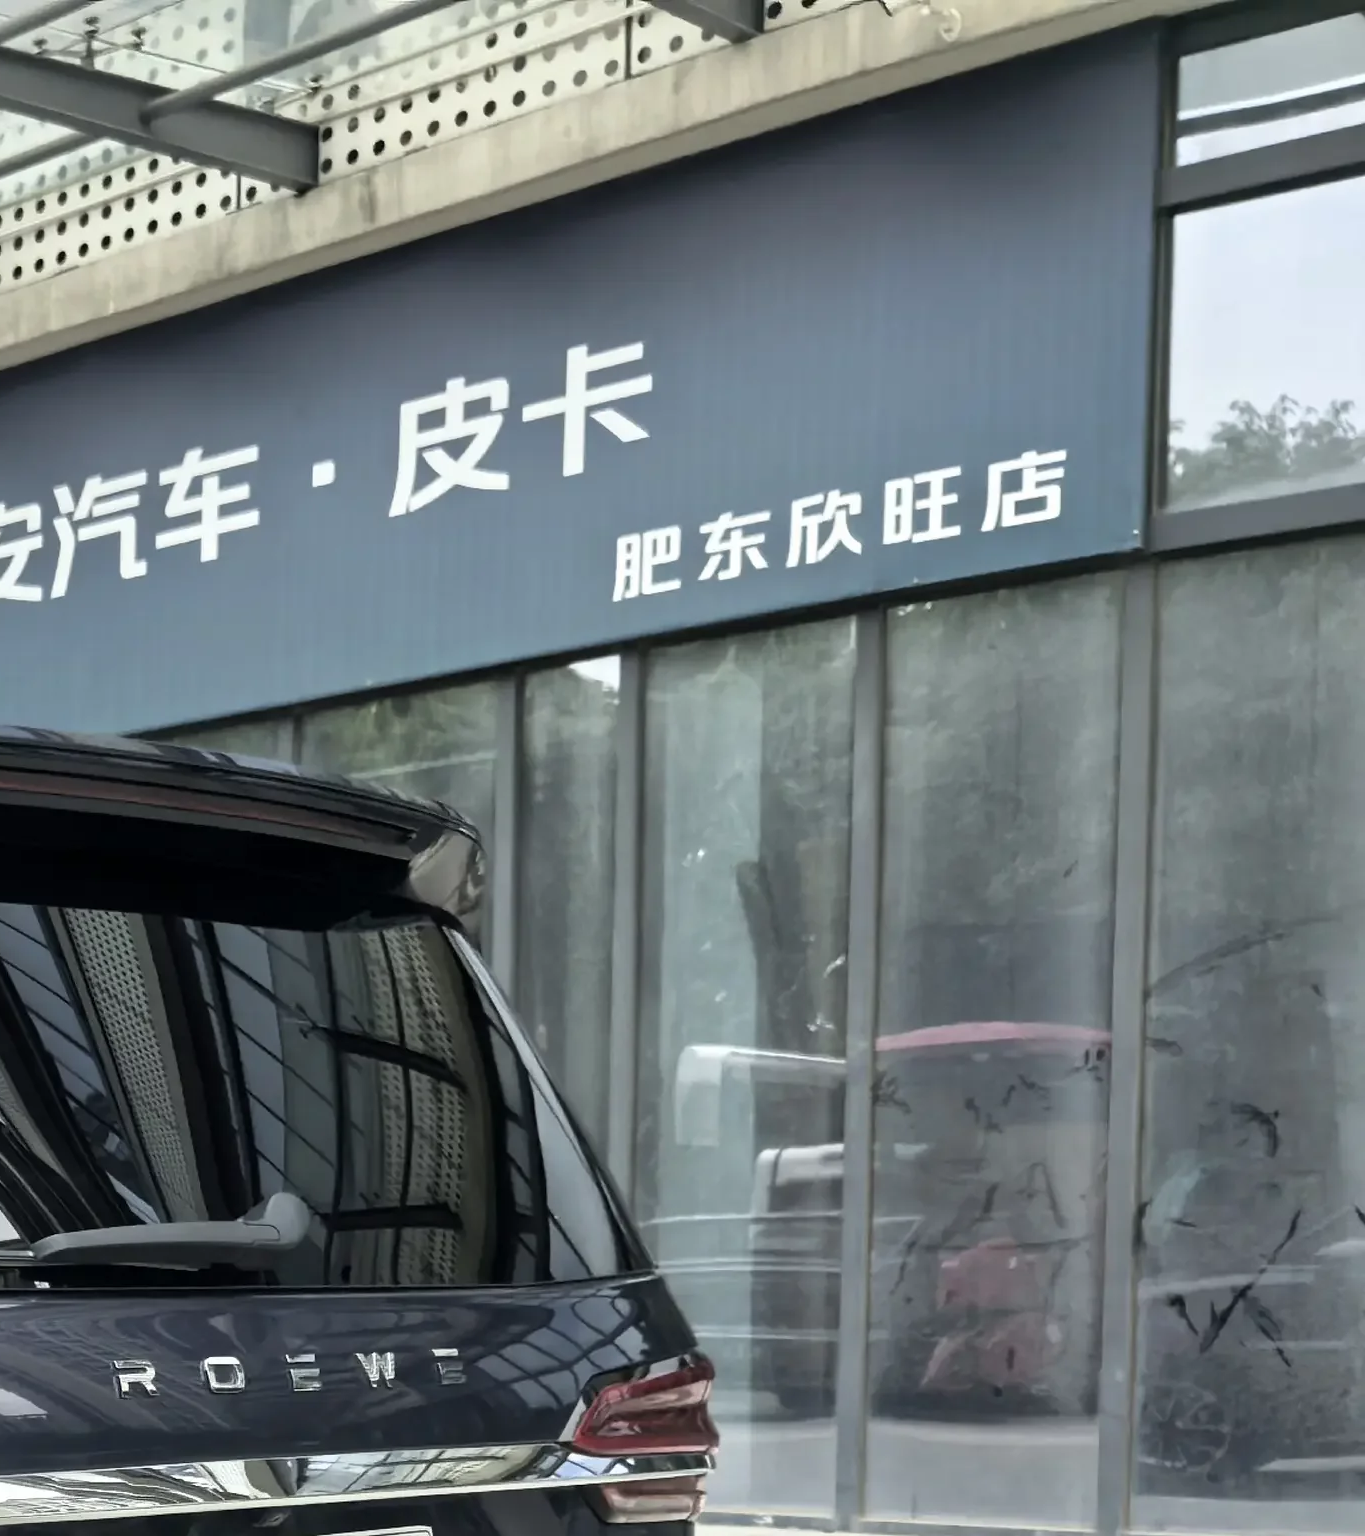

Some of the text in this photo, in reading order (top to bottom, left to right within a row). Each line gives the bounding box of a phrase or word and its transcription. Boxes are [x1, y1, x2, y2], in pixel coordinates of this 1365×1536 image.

[613, 449, 1067, 603] 肥东欣旺店
[111, 1348, 467, 1399] ROEWE
